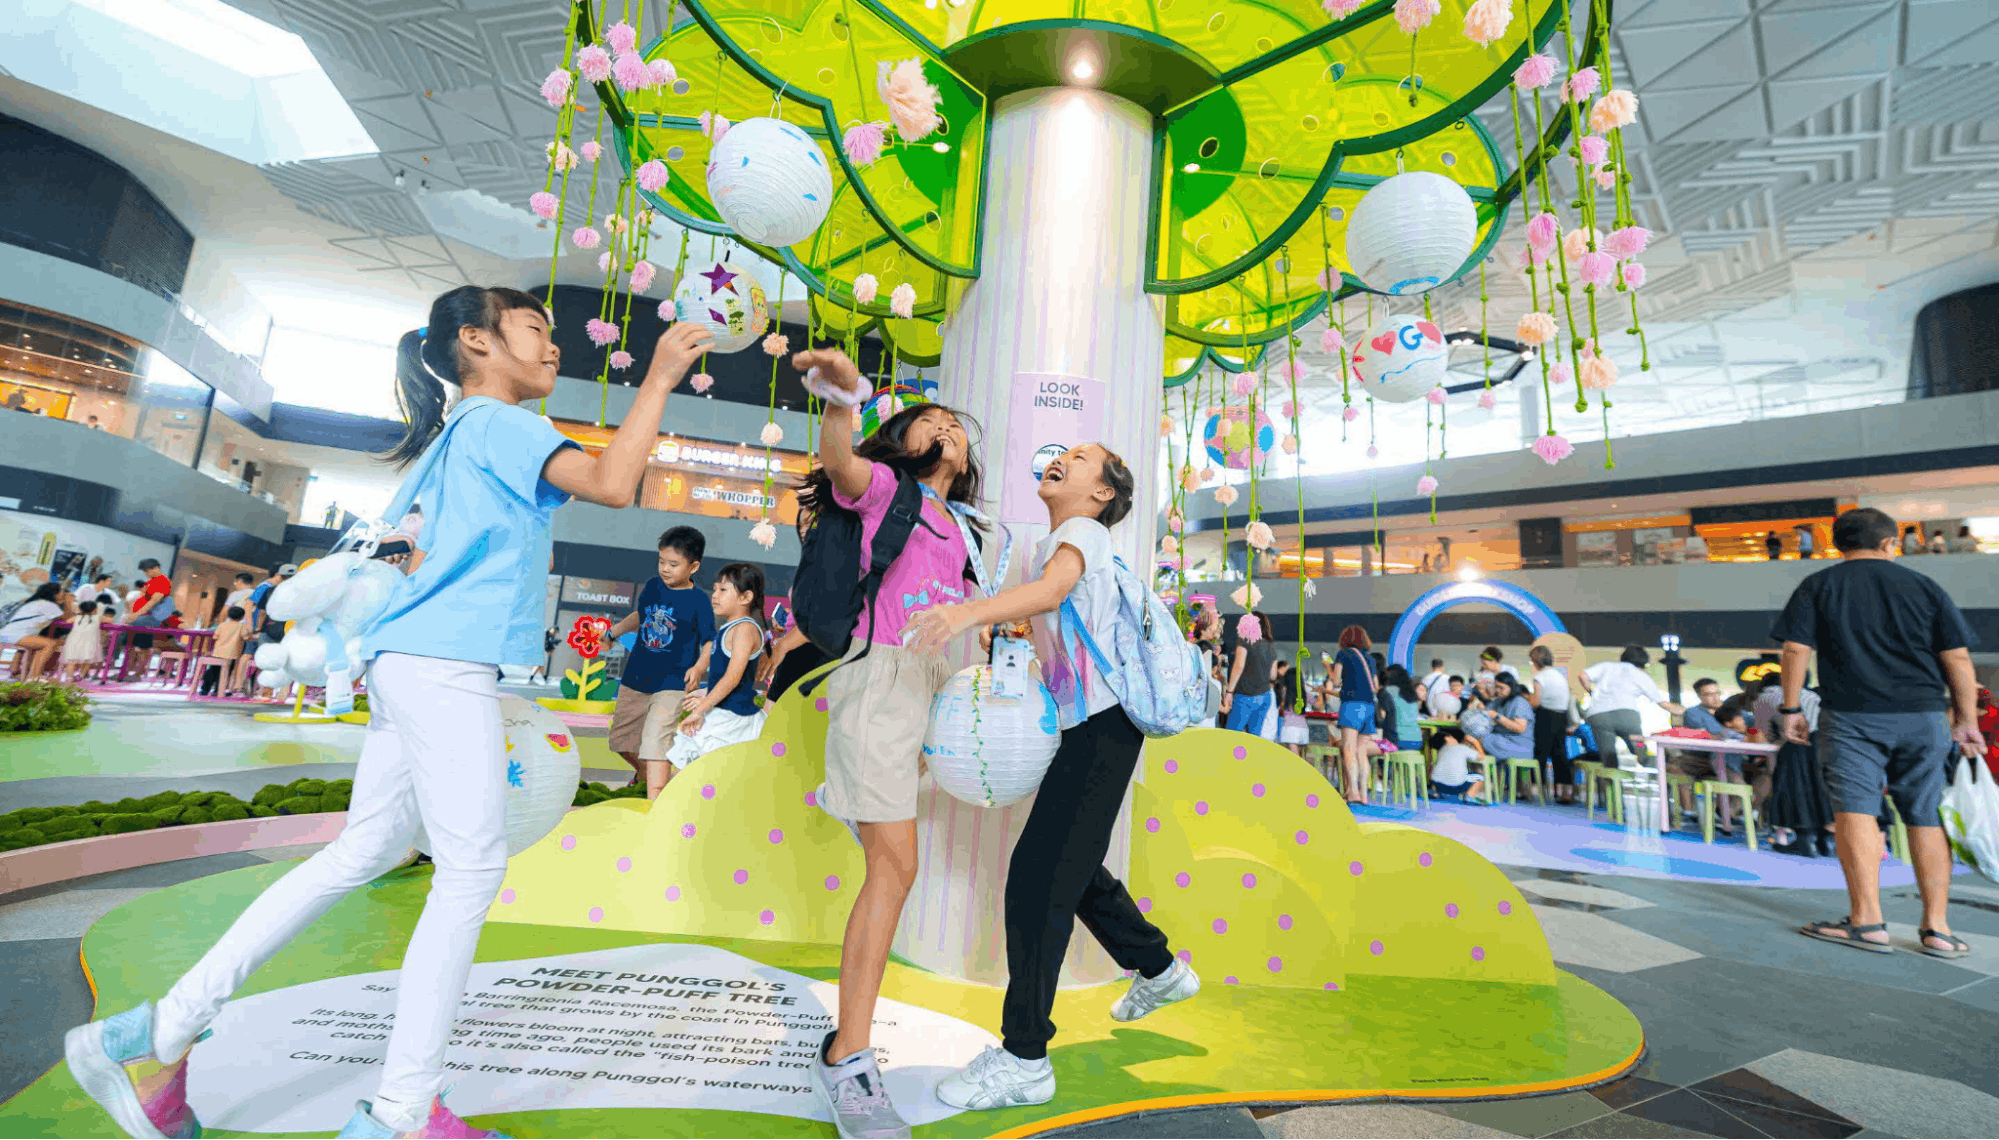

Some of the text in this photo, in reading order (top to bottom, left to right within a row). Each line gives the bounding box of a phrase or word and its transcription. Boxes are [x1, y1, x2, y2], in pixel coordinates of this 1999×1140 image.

[1399, 324, 1424, 350] G
[1039, 381, 1080, 396] LOOK
[1034, 395, 1084, 411] INSIDE!
[681, 445, 740, 467] BURGER
[577, 592, 630, 605] TOAST BOX
[493, 977, 798, 1006] POWDER-PUFF TREE
[531, 967, 787, 992] MEET PUNGGOL'S
[361, 984, 396, 993] Say
[474, 992, 582, 1005] Barringtonia
[689, 1006, 718, 1014] the
[724, 1008, 834, 1022] Powder-Puff
[478, 1001, 515, 1009] tree
[520, 1003, 557, 1012] that
[559, 1007, 615, 1016] grows
[619, 1009, 643, 1018] by
[647, 1012, 677, 1020] the
[681, 1015, 730, 1024] coast
[733, 1017, 750, 1025] in
[291, 1018, 336, 1027] and
[335, 1020, 394, 1031] moths
[478, 1029, 522, 1039] time
[573, 1036, 643, 1047] people
[649, 1042, 697, 1051] used
[701, 1044, 725, 1053] its
[730, 1046, 774, 1056] bark
[779, 1050, 817, 1059] and
[310, 1007, 336, 1016] Its
[460, 1018, 526, 1029] flowers
[528, 1022, 584, 1033] bloom
[586, 1026, 606, 1034] at
[662, 1032, 748, 1045] attracting
[329, 1031, 388, 1041] catch
[466, 1039, 498, 1049] it's
[501, 1042, 543, 1051] also
[547, 1045, 610, 1055] called
[613, 1049, 646, 1058] the
[289, 1051, 333, 1061] Can
[334, 1055, 378, 1065] you
[444, 1061, 475, 1071] his
[479, 1063, 524, 1074] tree
[527, 1068, 588, 1080] along
[592, 1070, 697, 1086] Punggol's
[703, 1079, 813, 1094] waterways
